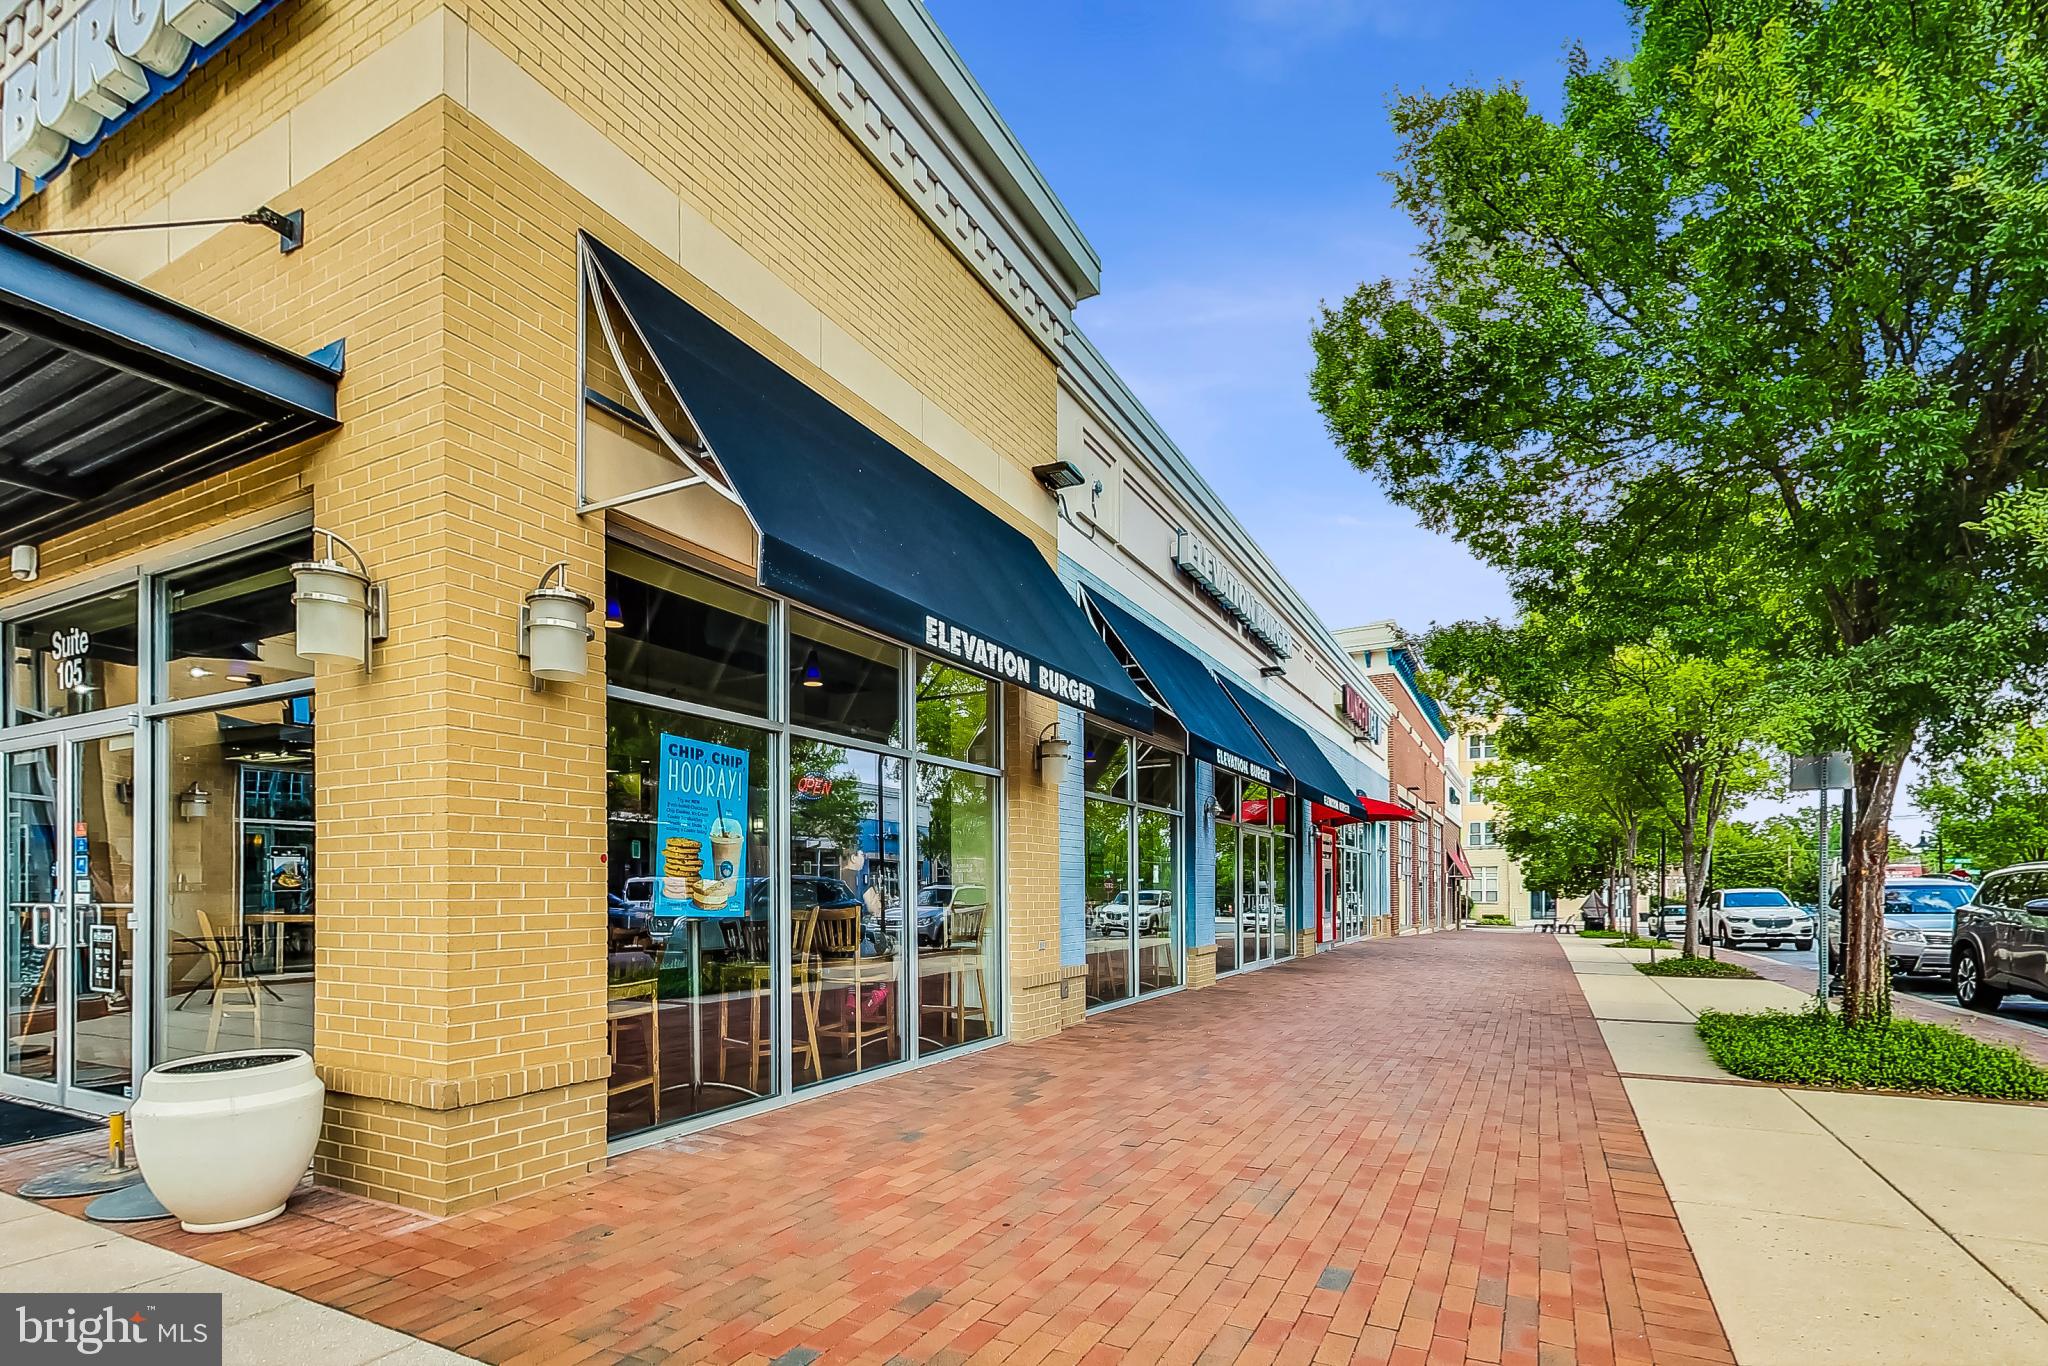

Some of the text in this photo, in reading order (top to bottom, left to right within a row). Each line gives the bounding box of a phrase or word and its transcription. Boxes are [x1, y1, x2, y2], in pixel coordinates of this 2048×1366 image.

[1187, 531, 1253, 623] ELEVATION
[52, 627, 89, 660] Suite
[57, 657, 83, 690] 105
[925, 615, 1096, 710] ELEVATION BURGER
[668, 743, 746, 773] CHIP, CHIP,
[1216, 748, 1271, 783] ELEVATION BURGER
[668, 758, 742, 801] HOORAY!
[797, 776, 832, 796] OPEN
